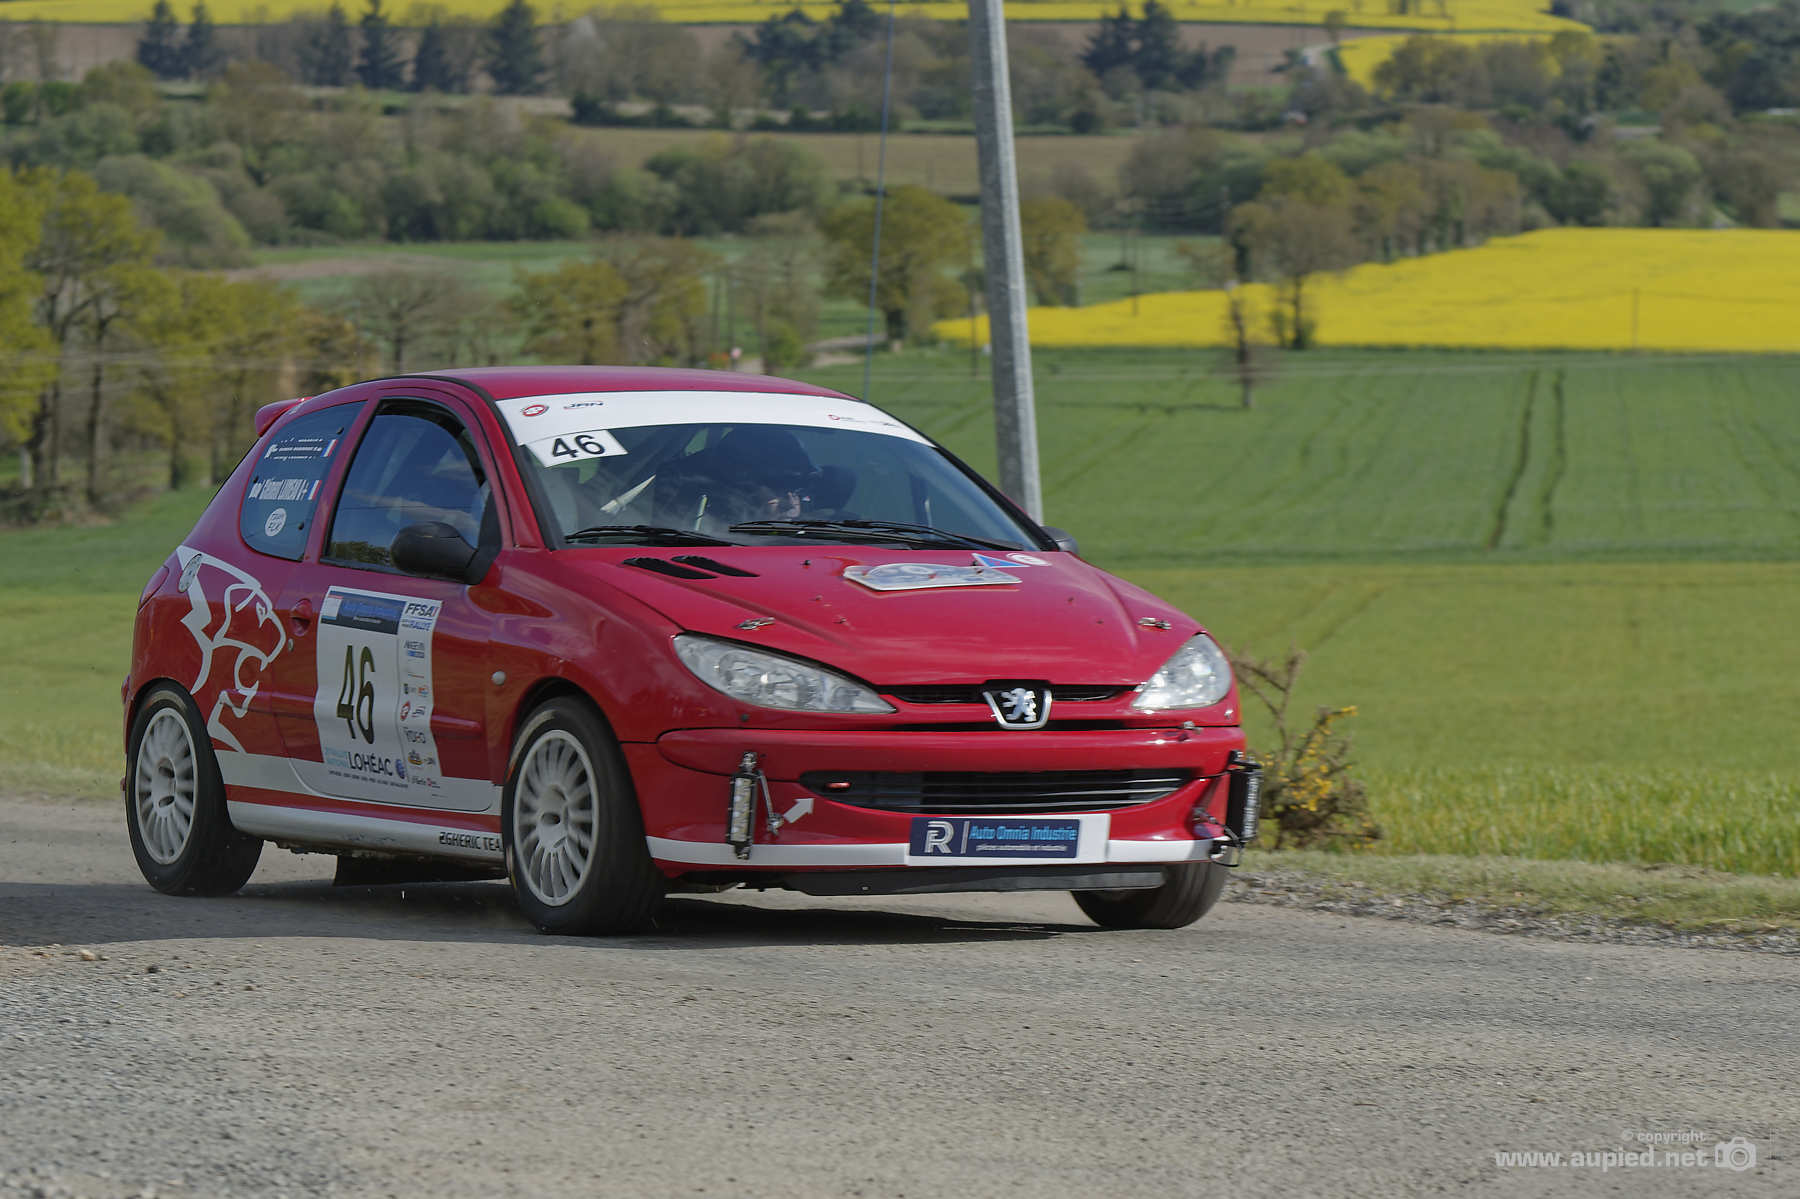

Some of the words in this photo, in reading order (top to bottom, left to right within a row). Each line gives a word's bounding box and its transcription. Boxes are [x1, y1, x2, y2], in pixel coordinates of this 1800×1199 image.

[552, 434, 605, 458] 46
[405, 603, 434, 616] FFSA
[337, 645, 375, 744] 46
[348, 752, 393, 776] LOHÉAC
[968, 826, 995, 840] Auto
[996, 826, 1029, 840] Omnia
